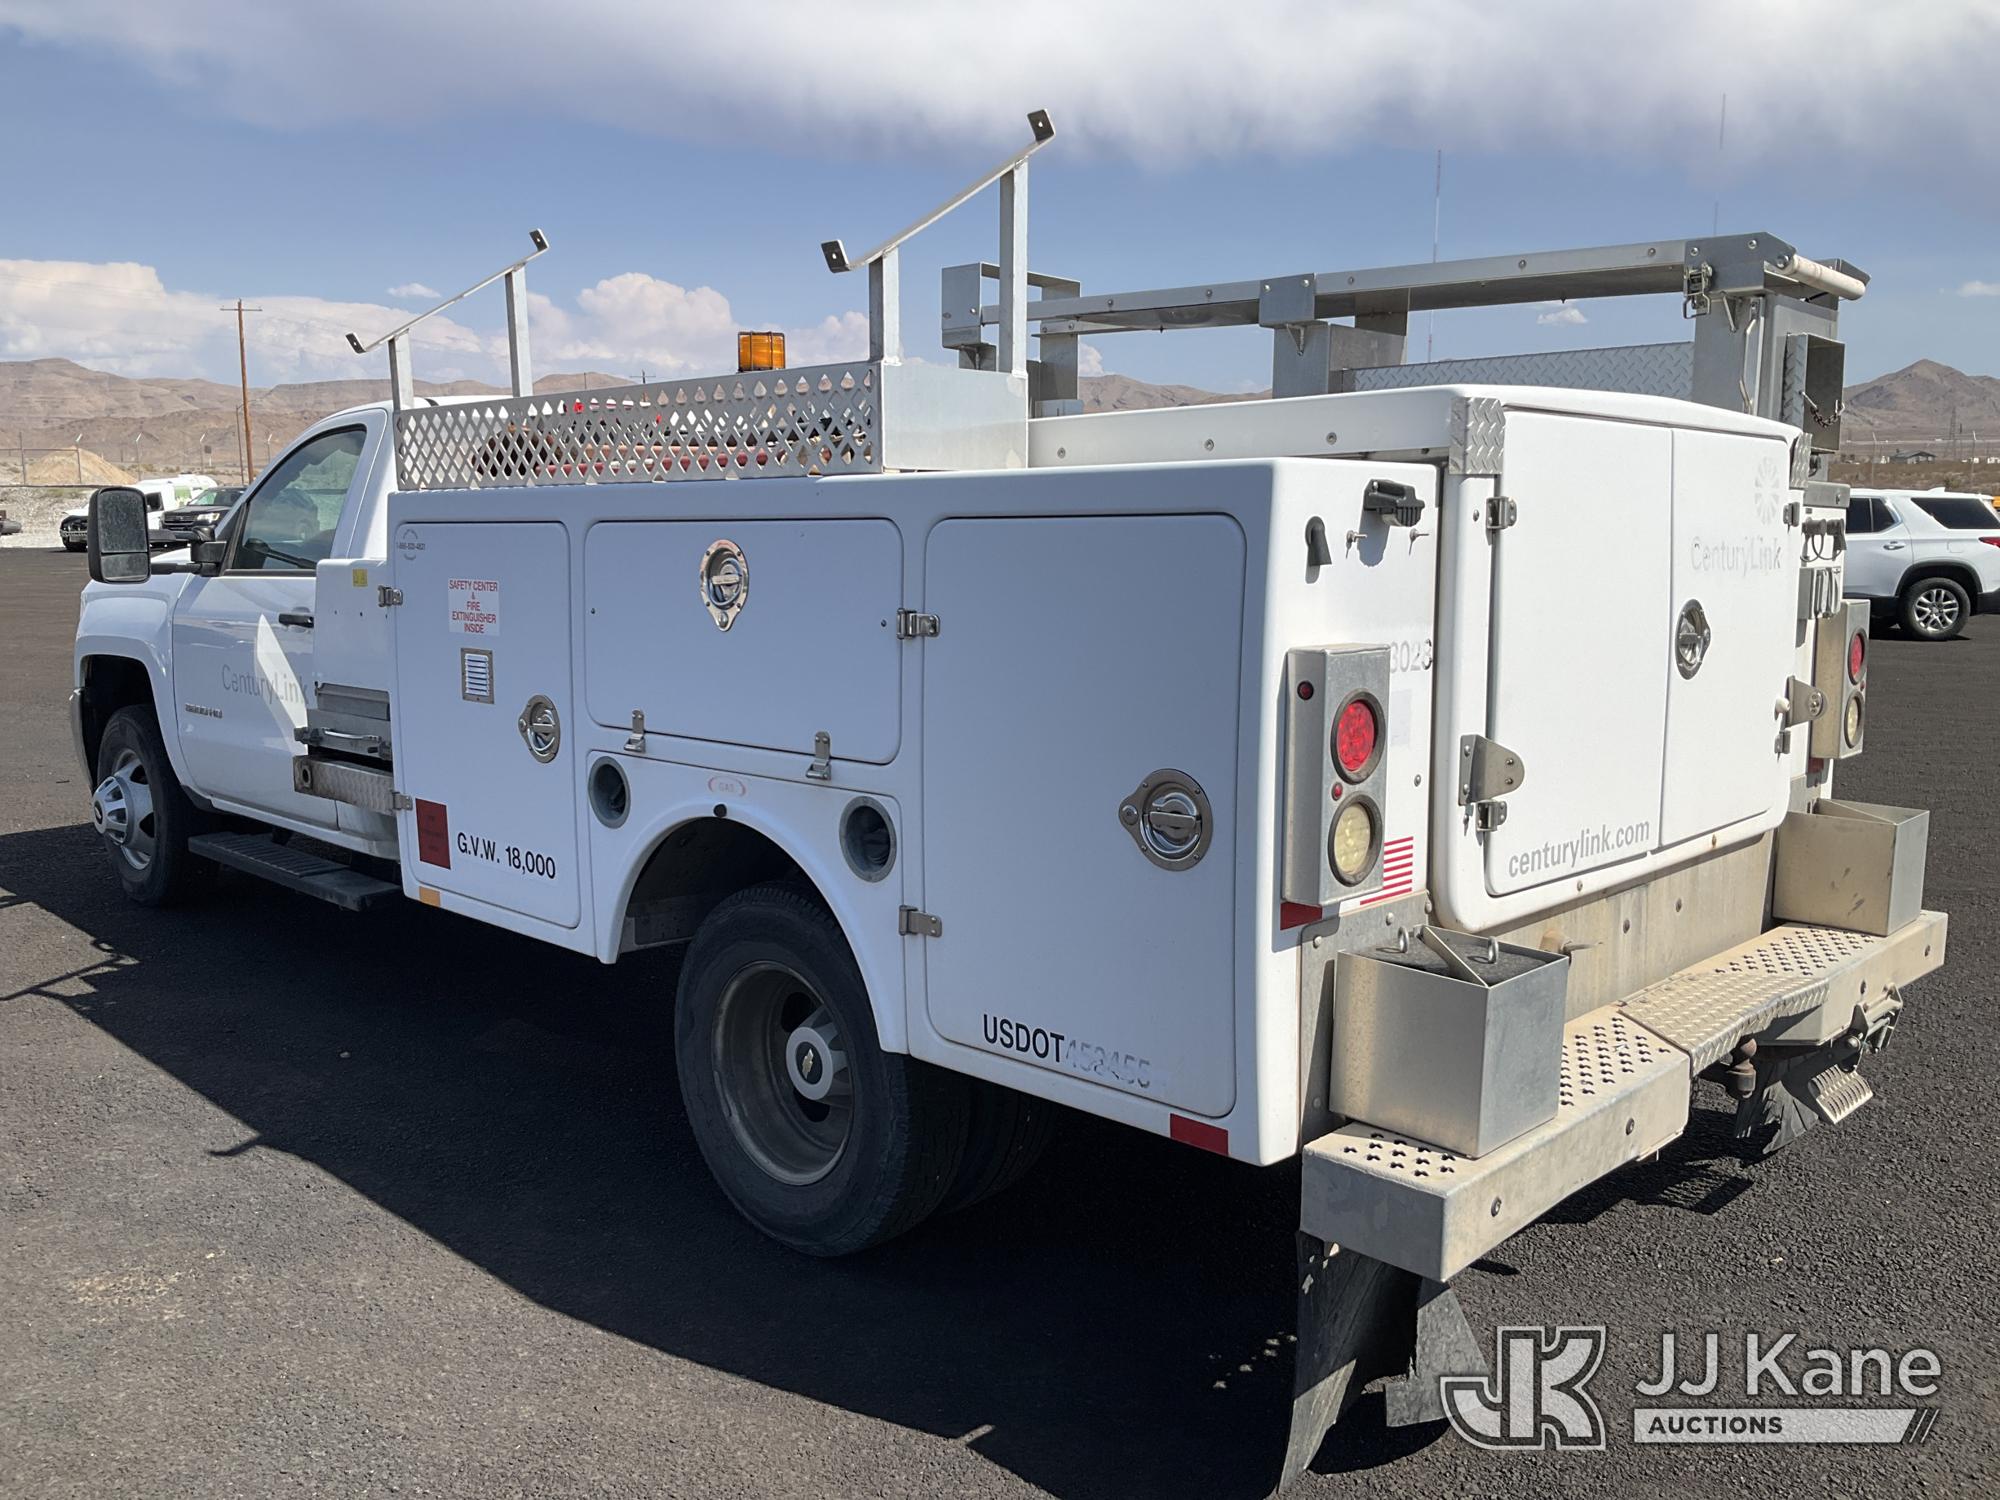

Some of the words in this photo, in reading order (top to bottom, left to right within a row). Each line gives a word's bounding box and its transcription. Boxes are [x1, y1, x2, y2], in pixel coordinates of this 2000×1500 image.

[1690, 536, 1781, 577] CenturyLink
[449, 579, 471, 590] SAFETY
[473, 581, 498, 592] CENTER
[466, 601, 481, 611] FIRE
[452, 611, 497, 624] EXTINGUISHER
[464, 623, 485, 634] INSIDE
[221, 664, 309, 705] CenturyLink
[457, 832, 500, 863] G.V.W.
[505, 845, 556, 879] 18,000
[1508, 821, 1650, 878] centurylink.com
[983, 1013, 1065, 1063] USDOT
